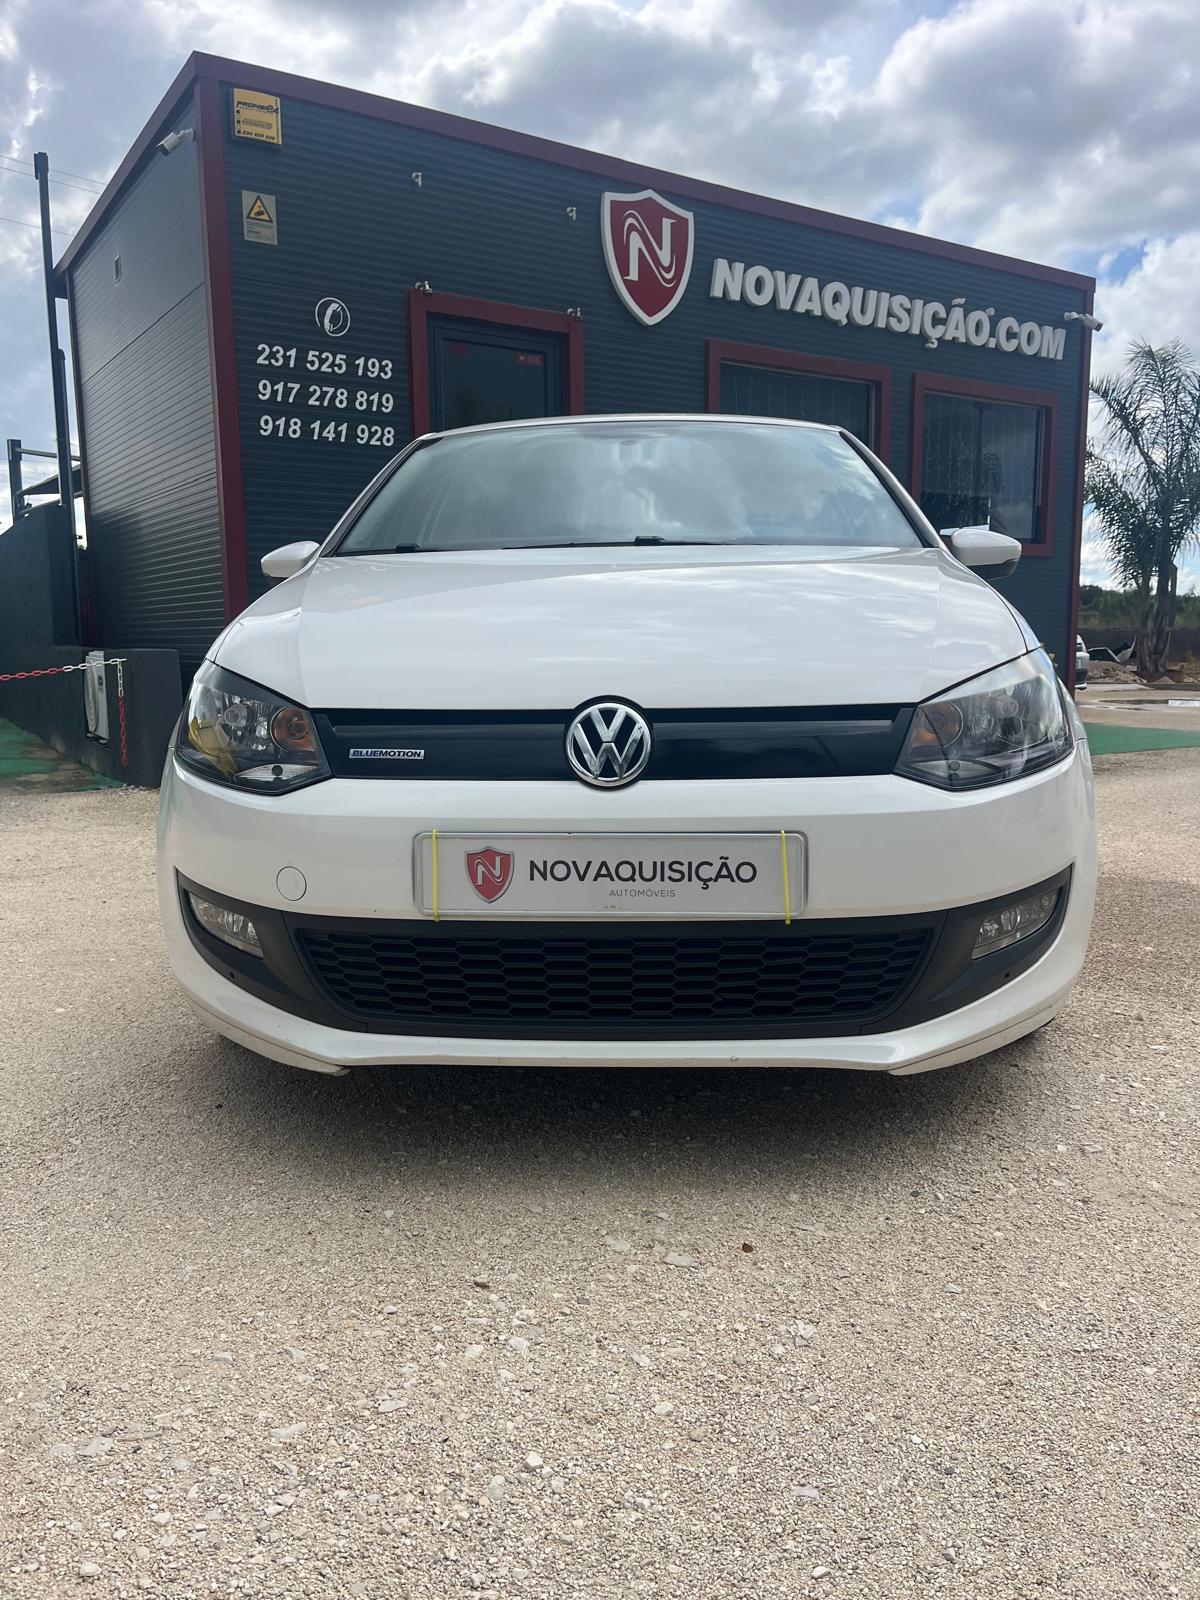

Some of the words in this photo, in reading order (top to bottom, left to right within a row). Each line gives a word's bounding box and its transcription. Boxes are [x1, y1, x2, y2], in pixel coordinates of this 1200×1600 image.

[710, 257, 1066, 360] NOVAQUISIÇÃO.COM
[256, 344, 297, 368] 231
[306, 350, 347, 374] 525
[354, 356, 393, 380] 193
[258, 379, 300, 403] 917
[308, 385, 348, 409] 278
[355, 390, 394, 413] 819
[259, 415, 302, 438] 918
[310, 420, 348, 443] 141
[356, 424, 395, 447] 928
[351, 749, 422, 759] BLUEMOTION
[567, 701, 652, 786] VW
[529, 856, 757, 890] NOVAQUISIÇÃO
[609, 888, 676, 898] AUTOMÓVEIS
